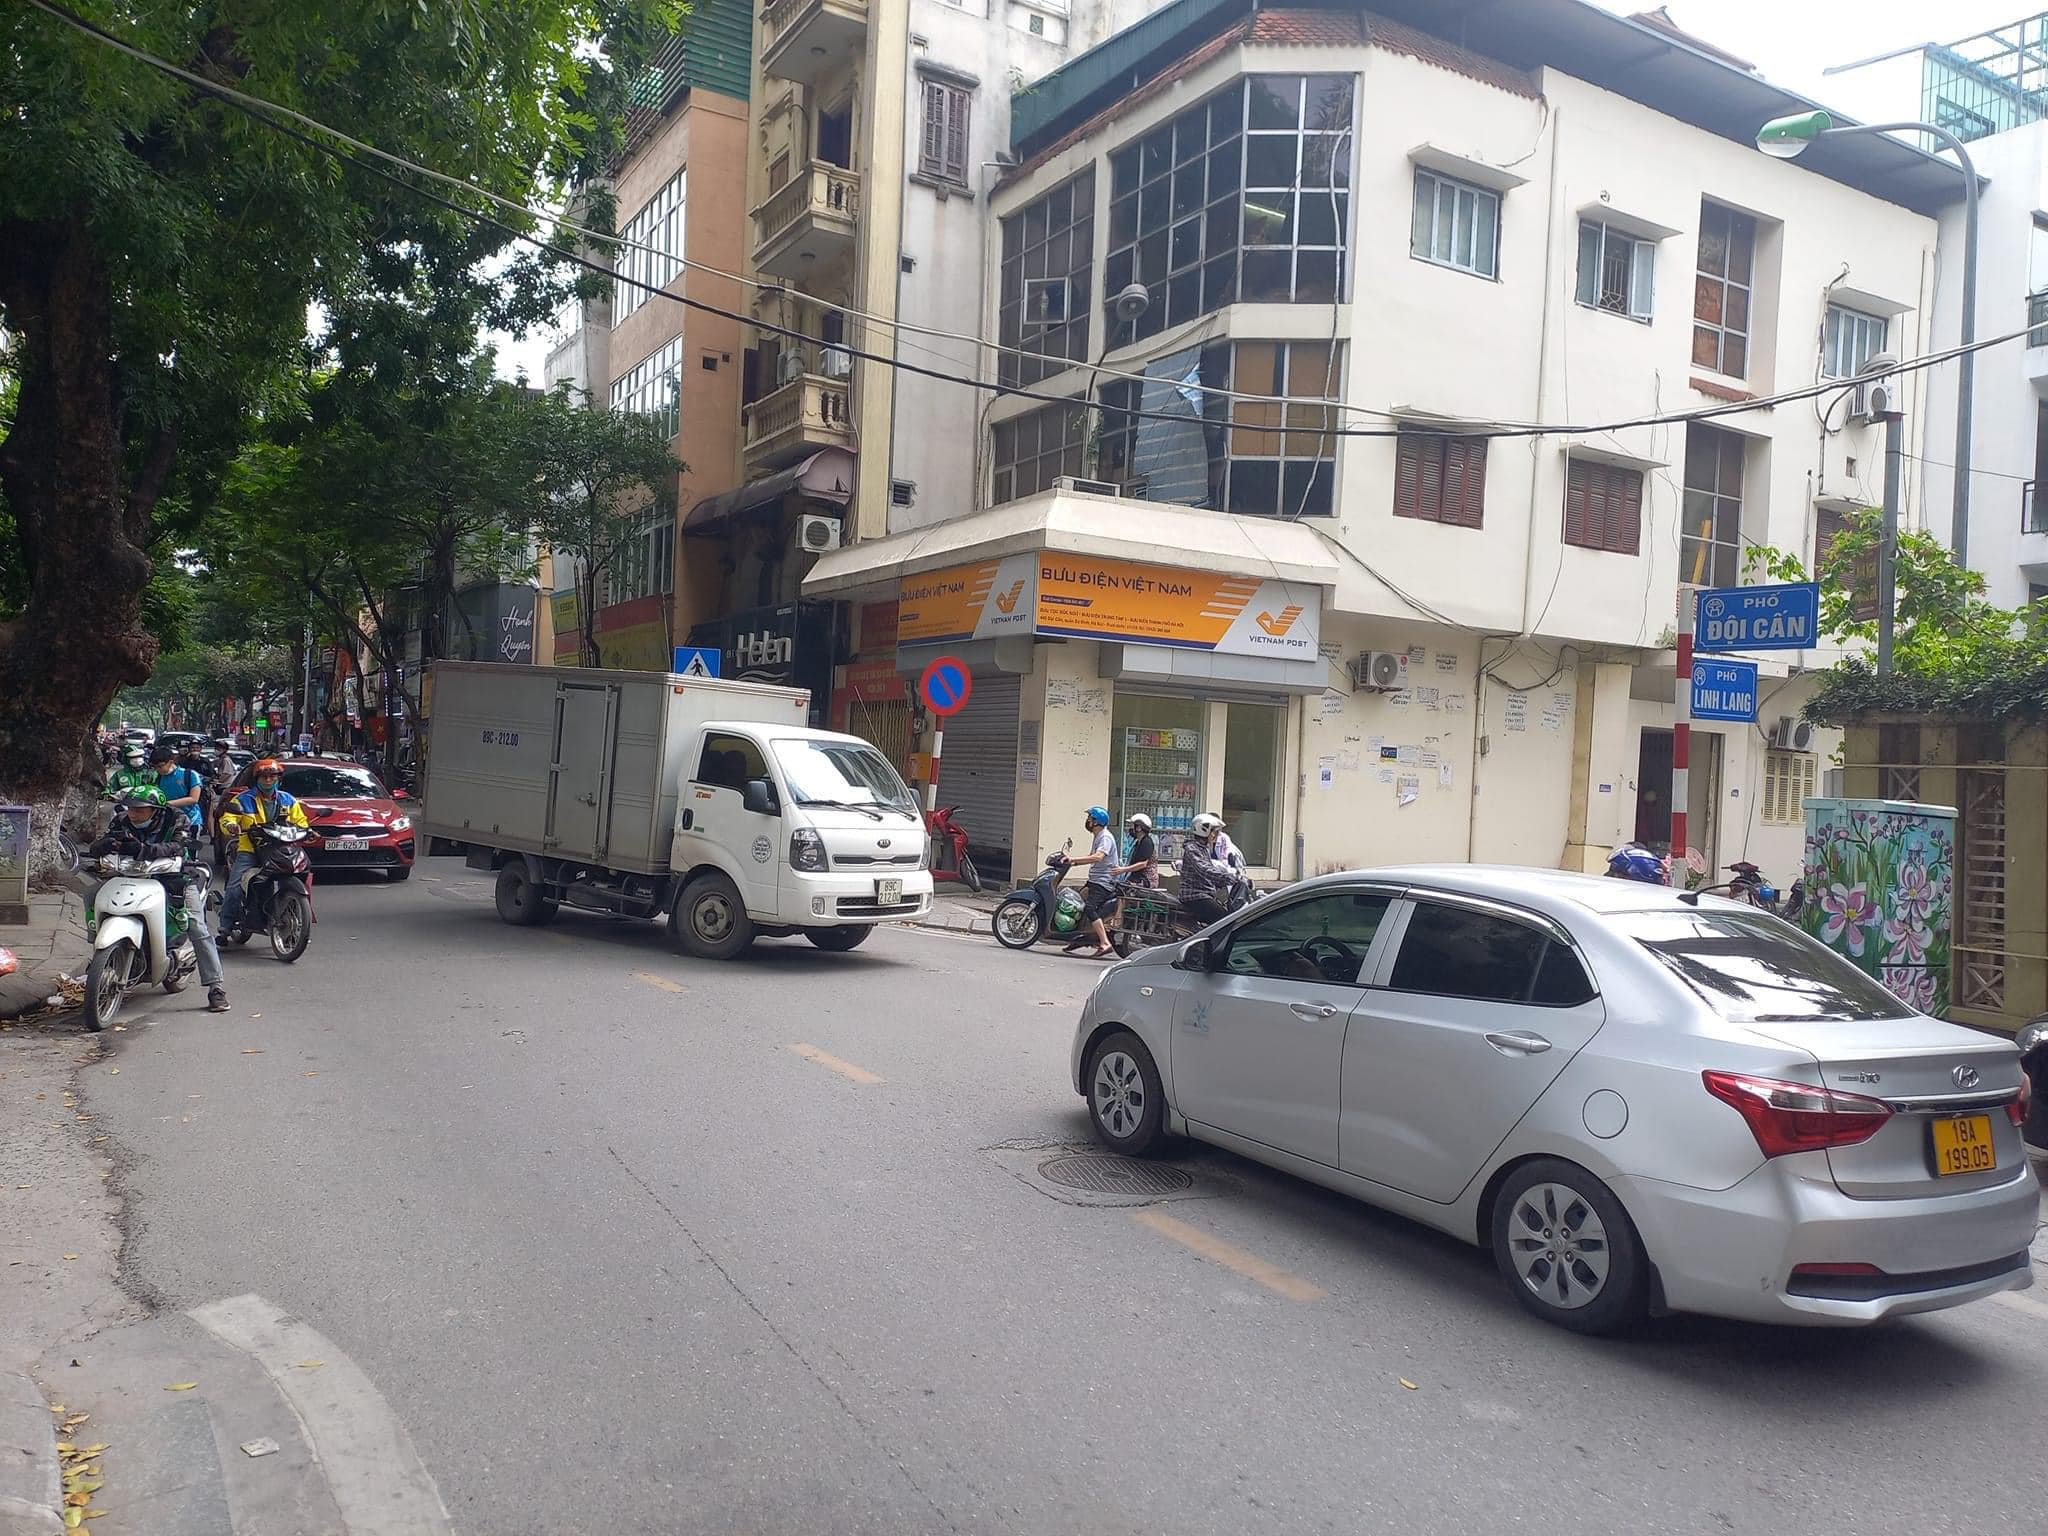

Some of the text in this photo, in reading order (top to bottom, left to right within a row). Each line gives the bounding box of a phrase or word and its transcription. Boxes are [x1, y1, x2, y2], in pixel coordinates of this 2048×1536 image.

[948, 582, 965, 592] NAM
[1041, 568, 1192, 596] BƯU ĐIỆN VIỆT NAM
[1744, 592, 1780, 608] PHỐ
[1012, 614, 1027, 622] POST
[1707, 610, 1805, 645] ĐỘI CẤN
[1249, 635, 1308, 648] VIETNAM POST
[1717, 667, 1737, 681] PHỐ
[1694, 689, 1751, 712] LINH LANG
[1952, 1120, 1977, 1143] 18A
[1946, 1145, 1990, 1170] 199.05
